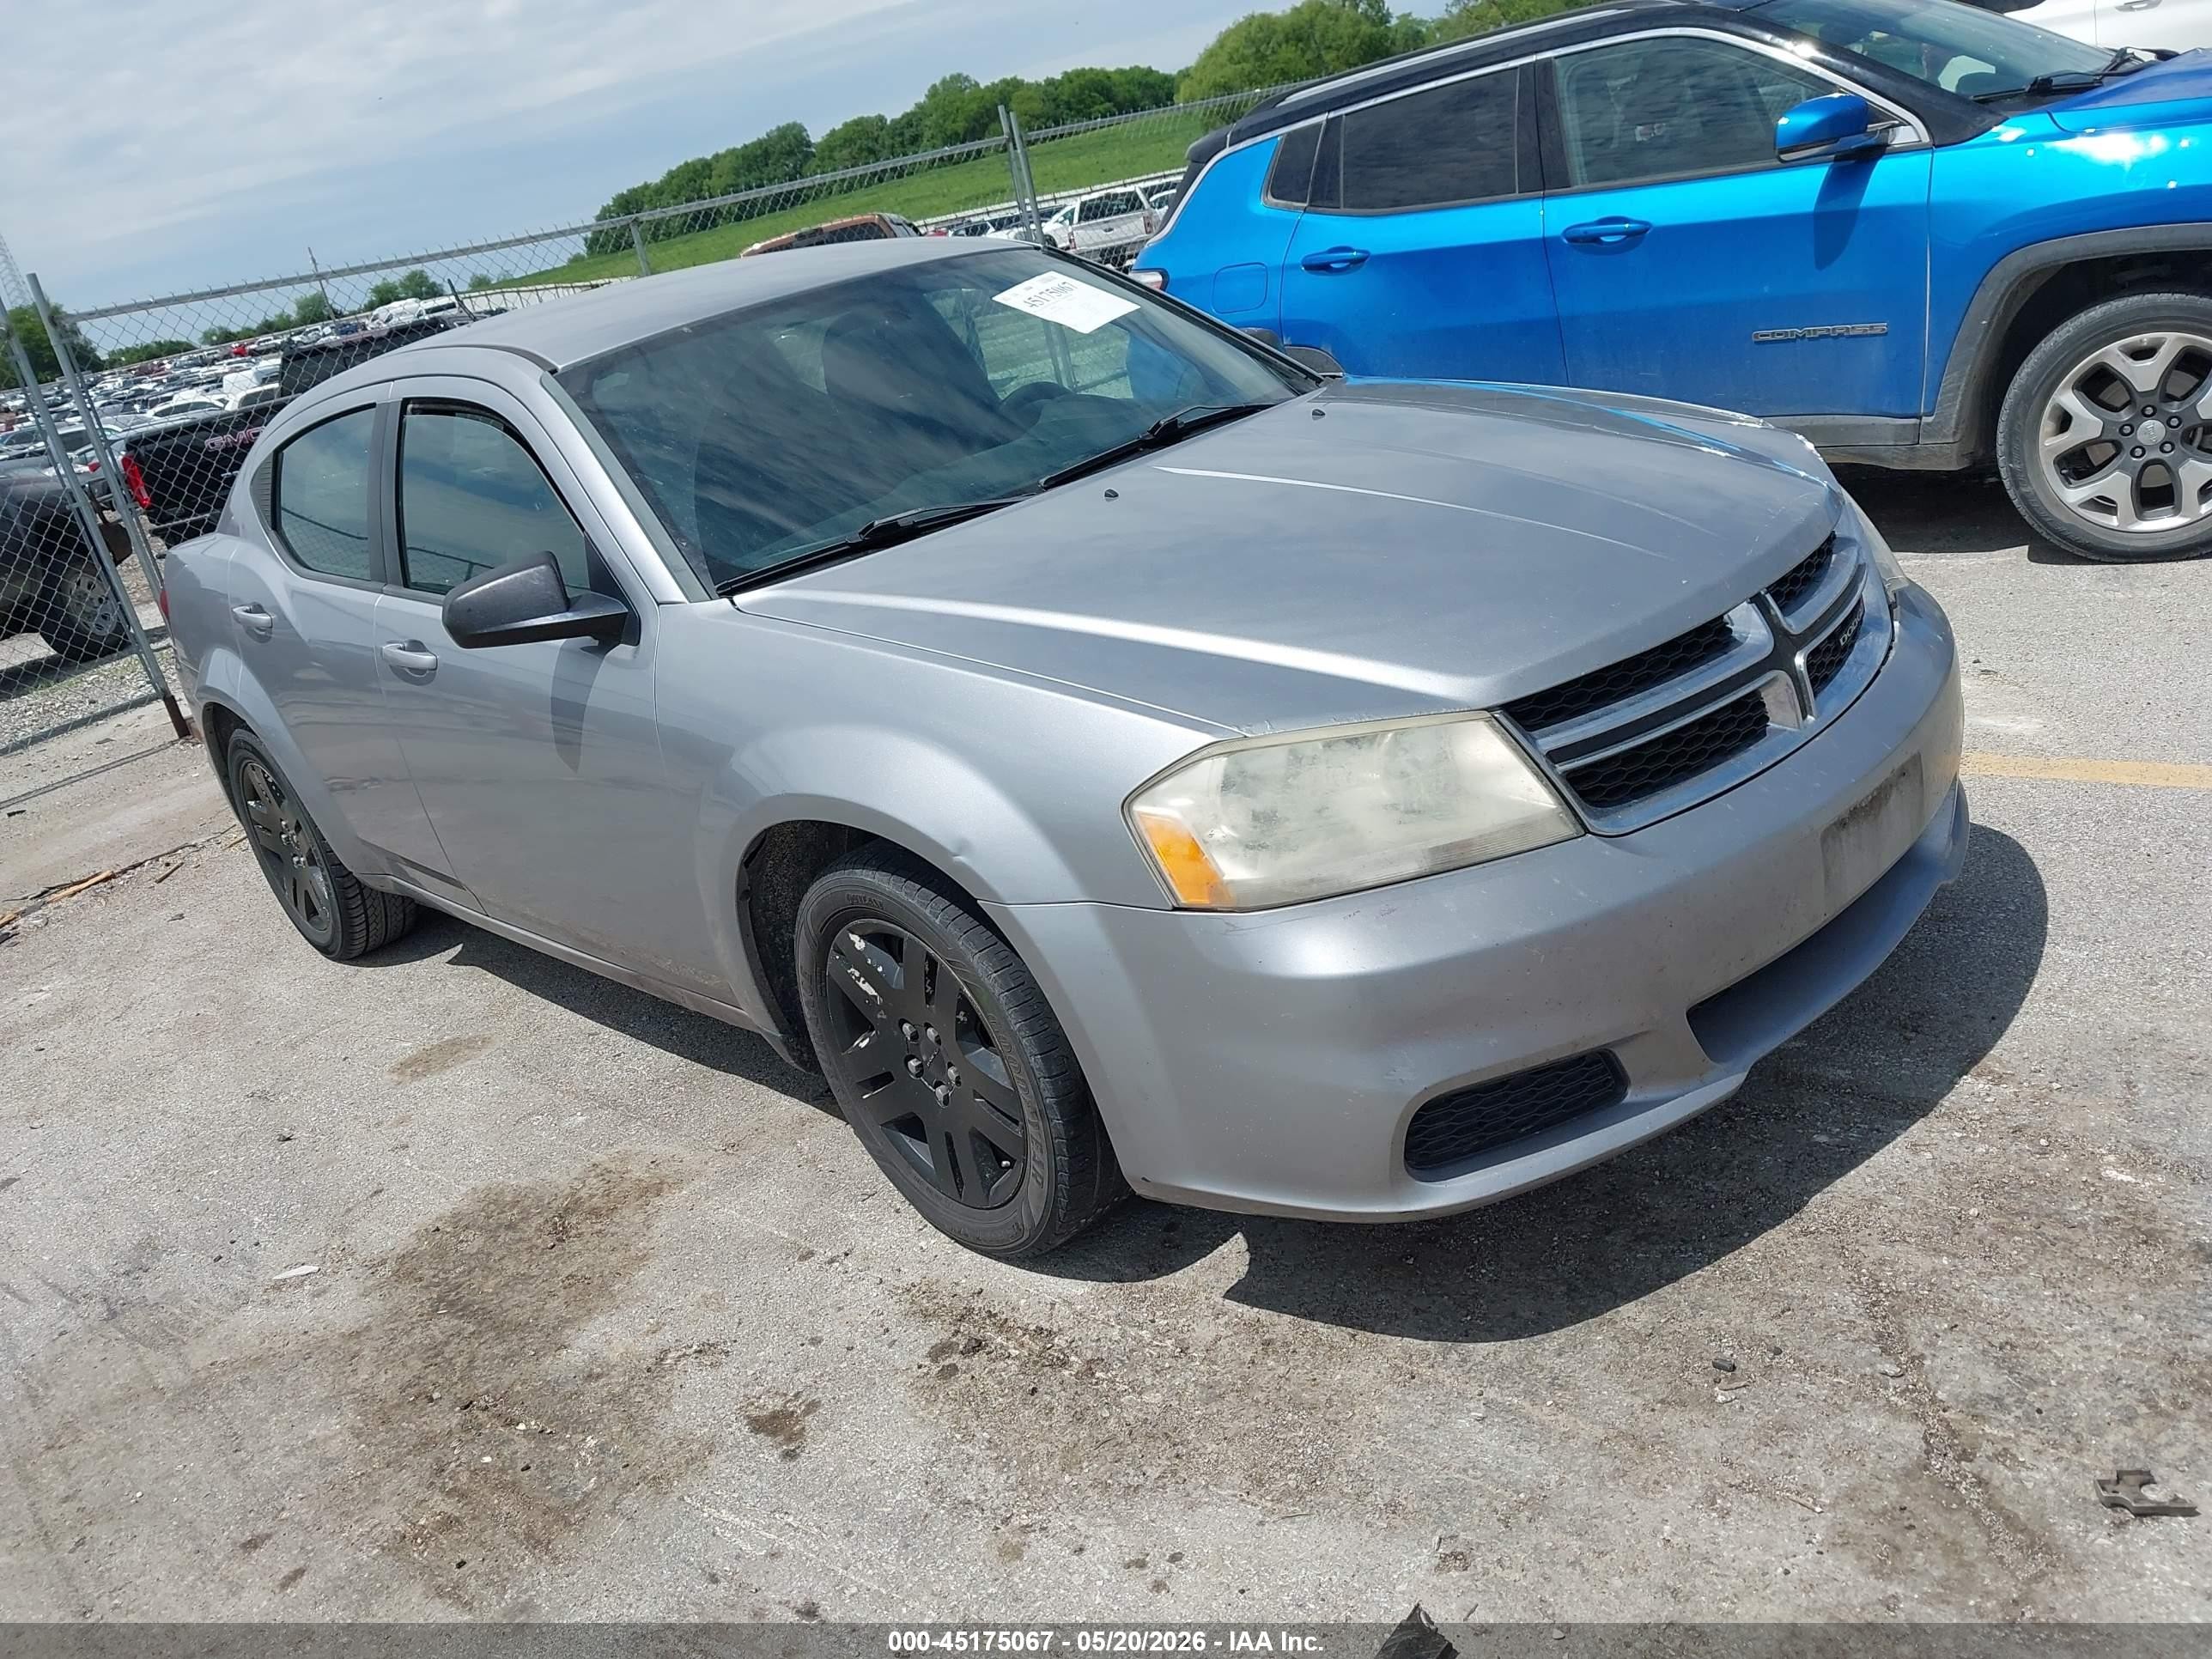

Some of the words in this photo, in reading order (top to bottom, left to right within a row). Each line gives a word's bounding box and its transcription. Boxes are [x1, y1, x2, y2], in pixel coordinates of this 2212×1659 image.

[1023, 281, 1078, 307] 45175067
[1752, 322, 1888, 341] COMPASS
[204, 427, 264, 452] GMC
